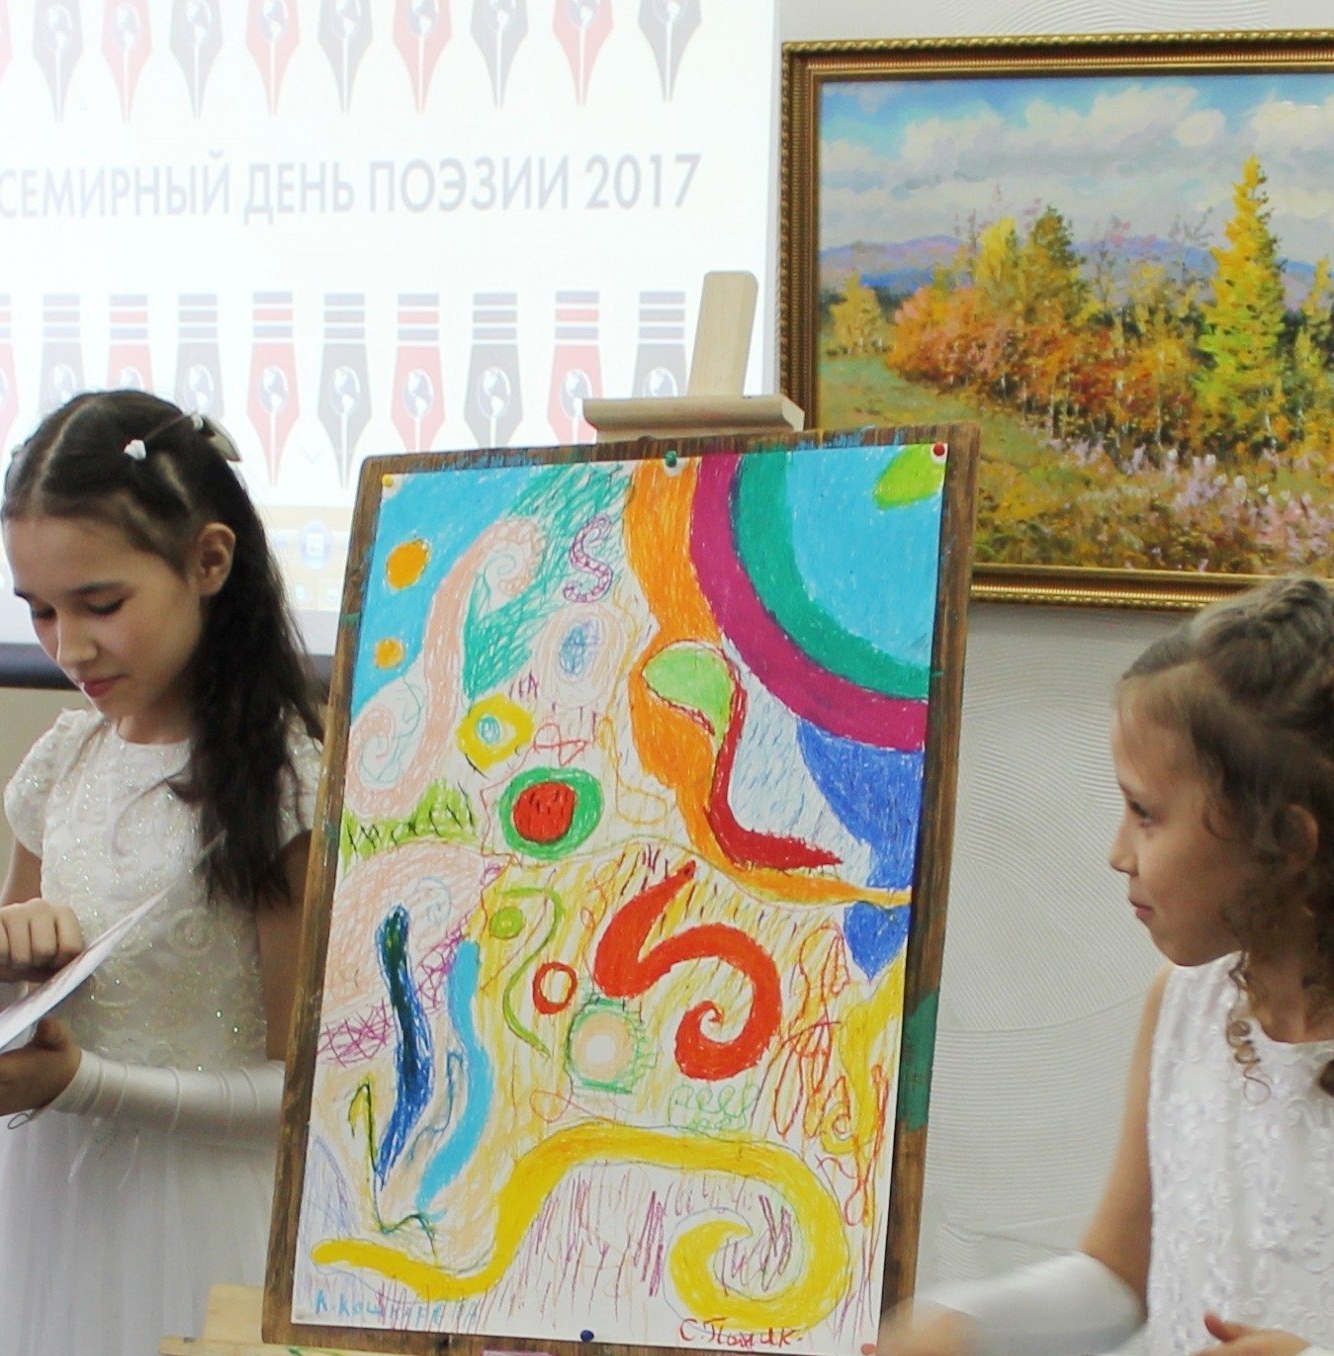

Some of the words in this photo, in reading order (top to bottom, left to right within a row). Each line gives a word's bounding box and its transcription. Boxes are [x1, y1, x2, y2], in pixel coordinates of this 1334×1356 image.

[243, 161, 355, 226] ДЕНЬ
[369, 154, 570, 213] ПОЭЗИИ
[584, 153, 703, 210] 2017
